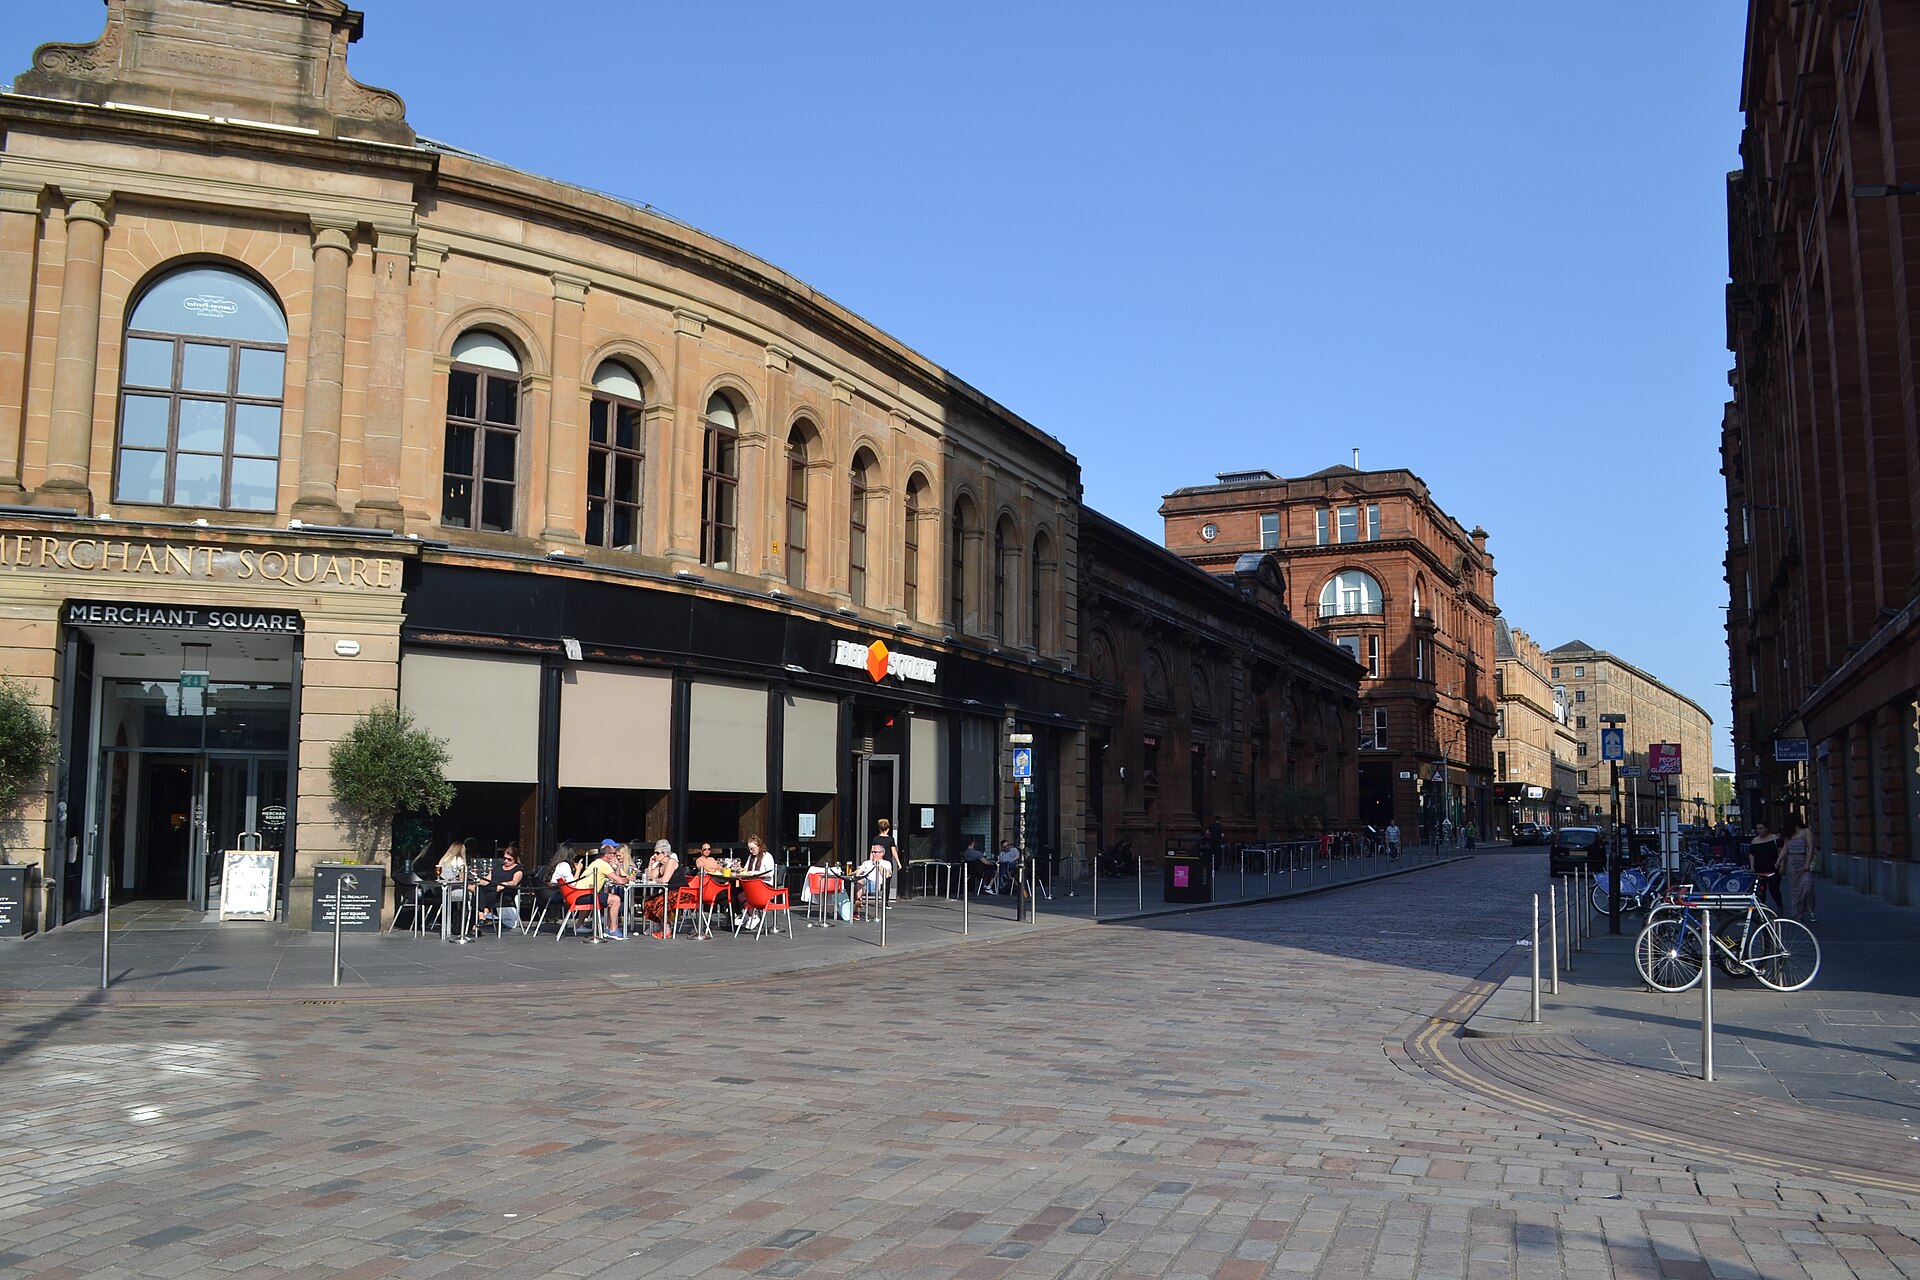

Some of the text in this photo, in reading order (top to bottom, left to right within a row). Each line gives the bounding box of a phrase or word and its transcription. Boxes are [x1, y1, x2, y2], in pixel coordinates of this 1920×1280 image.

[150, 47, 242, 73] REBUILT
[236, 548, 394, 588] SQUARE
[69, 604, 298, 631] MERCHANT SQUARE
[835, 640, 938, 683] BAR SQUARE
